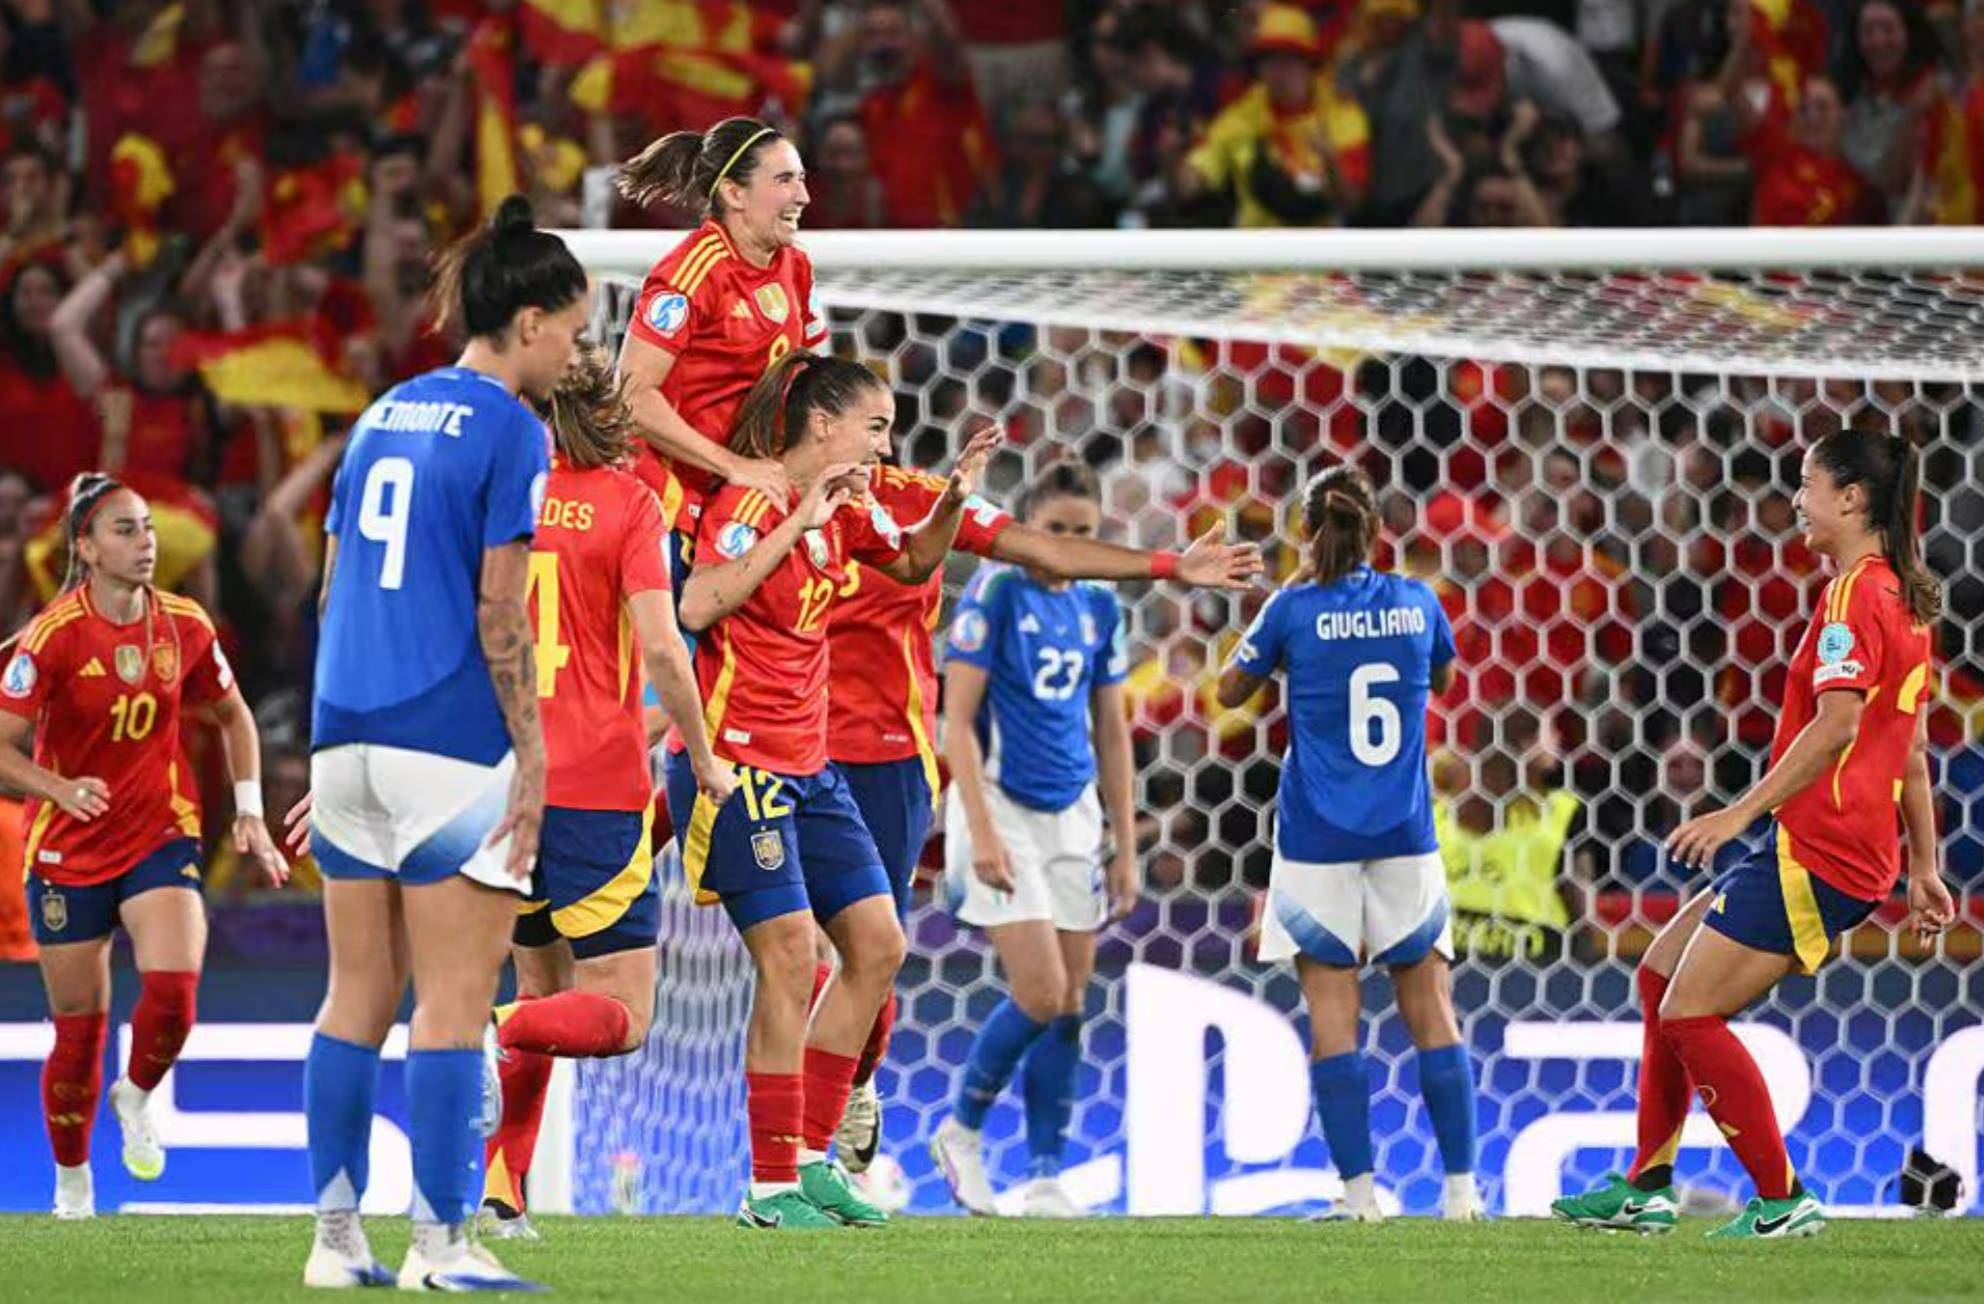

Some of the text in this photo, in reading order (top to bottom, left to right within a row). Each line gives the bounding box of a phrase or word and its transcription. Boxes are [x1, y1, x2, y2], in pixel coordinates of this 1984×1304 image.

[358, 456, 415, 590] 9
[524, 551, 571, 698] 4
[796, 576, 834, 634] 12
[1316, 606, 1426, 640] GIUGLIANO
[1034, 646, 1084, 700] 23
[110, 692, 157, 742] 10
[1350, 662, 1401, 767] 6
[737, 765, 790, 822] 12
